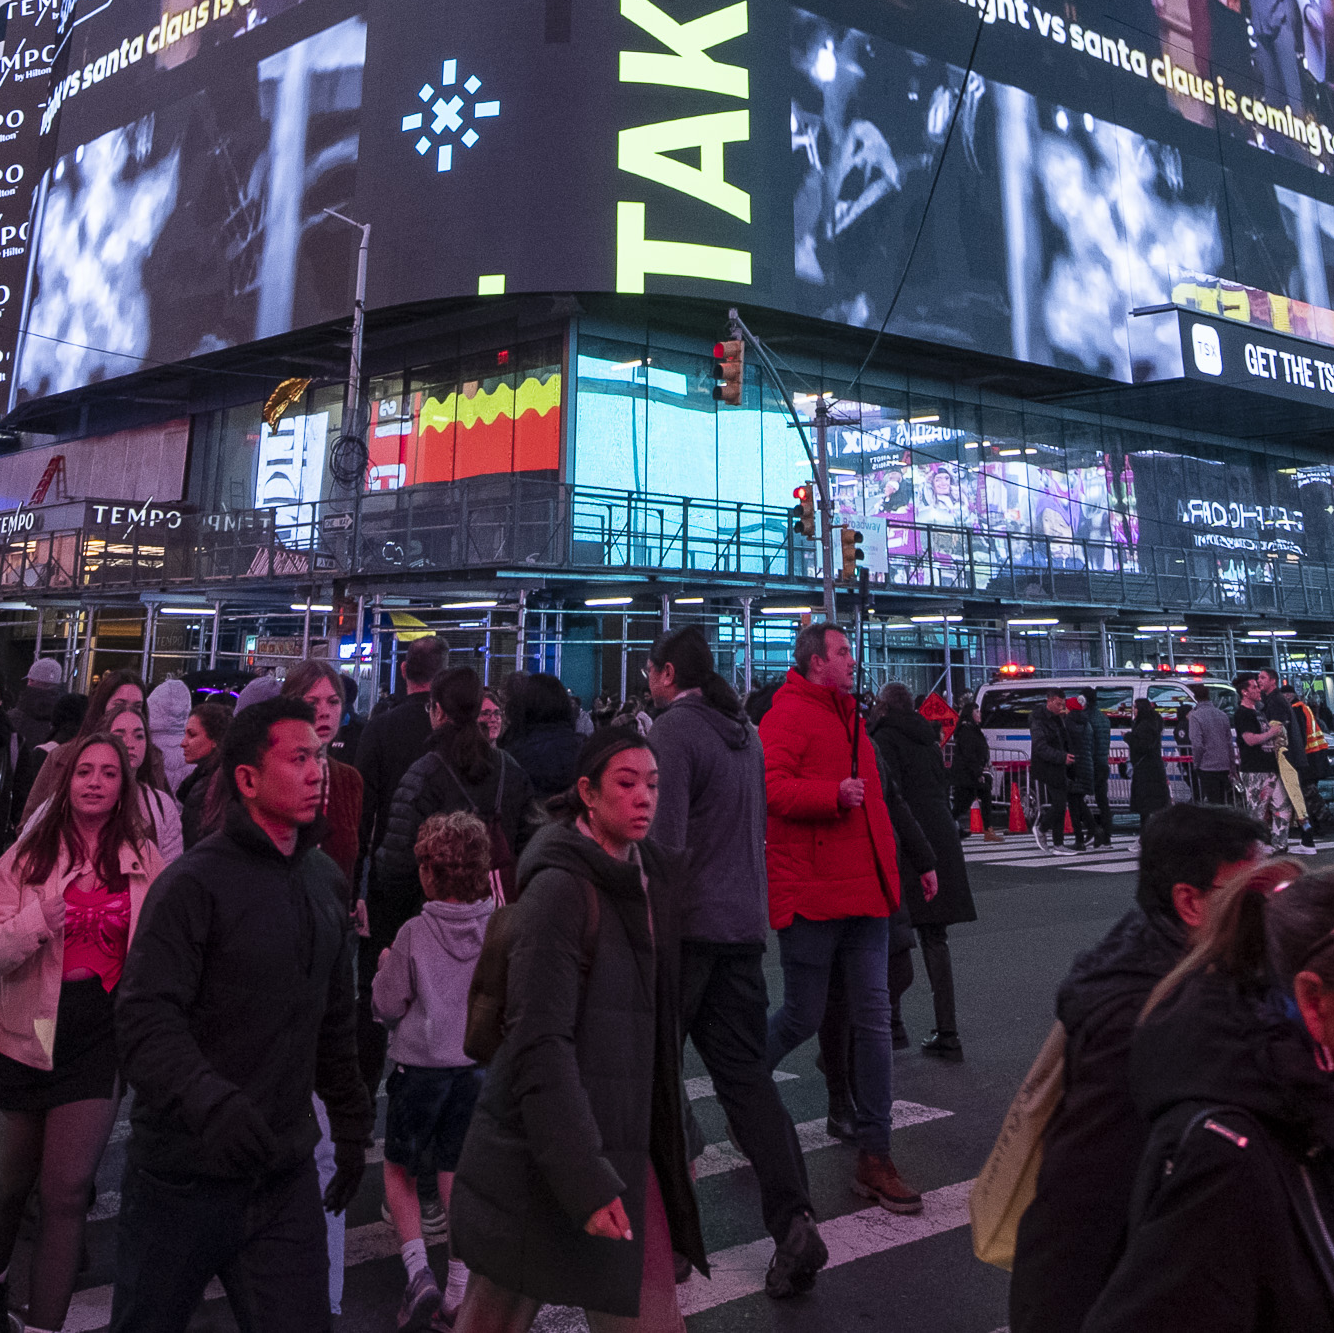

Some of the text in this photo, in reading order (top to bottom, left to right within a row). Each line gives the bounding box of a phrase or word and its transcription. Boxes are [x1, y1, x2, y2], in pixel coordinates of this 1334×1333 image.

[81, 34, 144, 91] santa
[146, 0, 209, 54] claus
[1032, 5, 1067, 44] vs
[1069, 24, 1147, 78] santa
[1151, 54, 1216, 105] claus
[1217, 77, 1239, 114] is
[1240, 95, 1323, 157] coming
[1197, 341, 1217, 357] TSX
[1245, 343, 1277, 379] GET
[1279, 352, 1315, 389] THE
[93, 499, 182, 536] TEMPO
